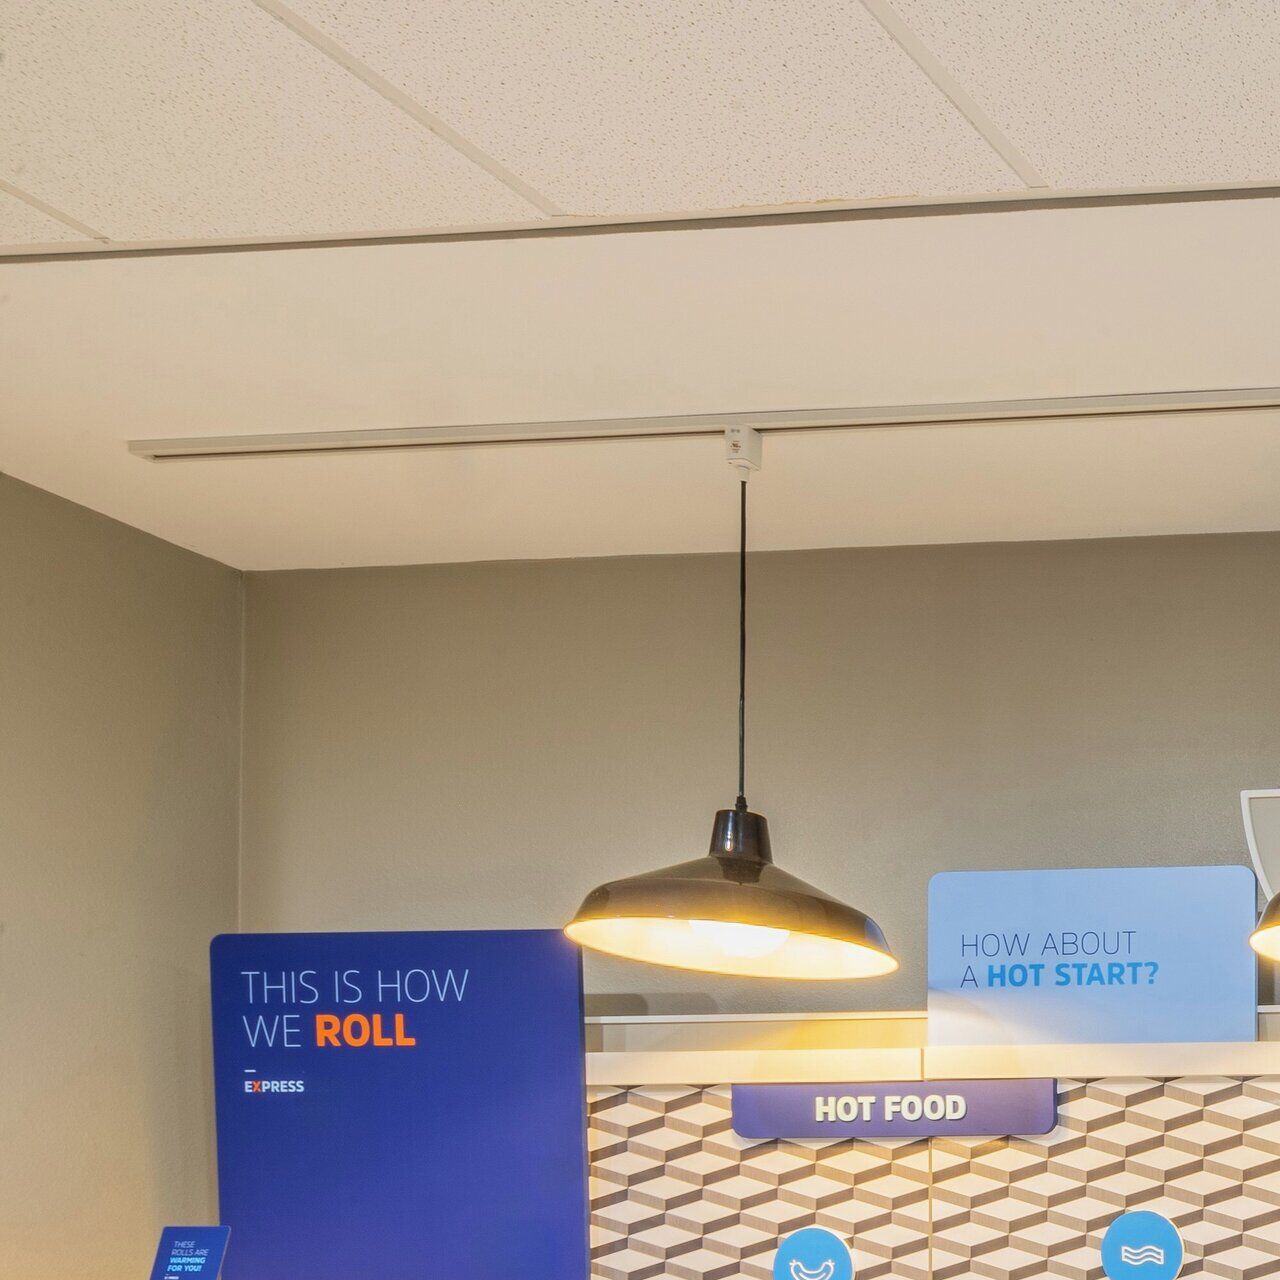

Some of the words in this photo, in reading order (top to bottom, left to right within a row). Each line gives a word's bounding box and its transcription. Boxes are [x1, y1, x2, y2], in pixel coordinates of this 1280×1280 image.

[961, 933, 1030, 958] HOW
[1041, 931, 1136, 956] ABOUT
[959, 965, 979, 989] A
[987, 963, 1045, 988] HOT
[1054, 961, 1160, 987] START?
[241, 970, 319, 1004] THIS
[334, 970, 362, 1003] IS
[378, 969, 469, 1003] HOW
[242, 1015, 301, 1048] WE
[315, 1013, 416, 1047] ROLL
[244, 1080, 305, 1093] EXPRESS
[815, 1096, 876, 1123] HOT
[884, 1094, 967, 1122] FOOD
[171, 1248, 193, 1257] ROLLS
[193, 1248, 209, 1257] ARE
[174, 1240, 196, 1249] THESE
[167, 1264, 182, 1272] FOR
[184, 1264, 202, 1272] YOU!
[169, 1256, 206, 1264] WARMING
